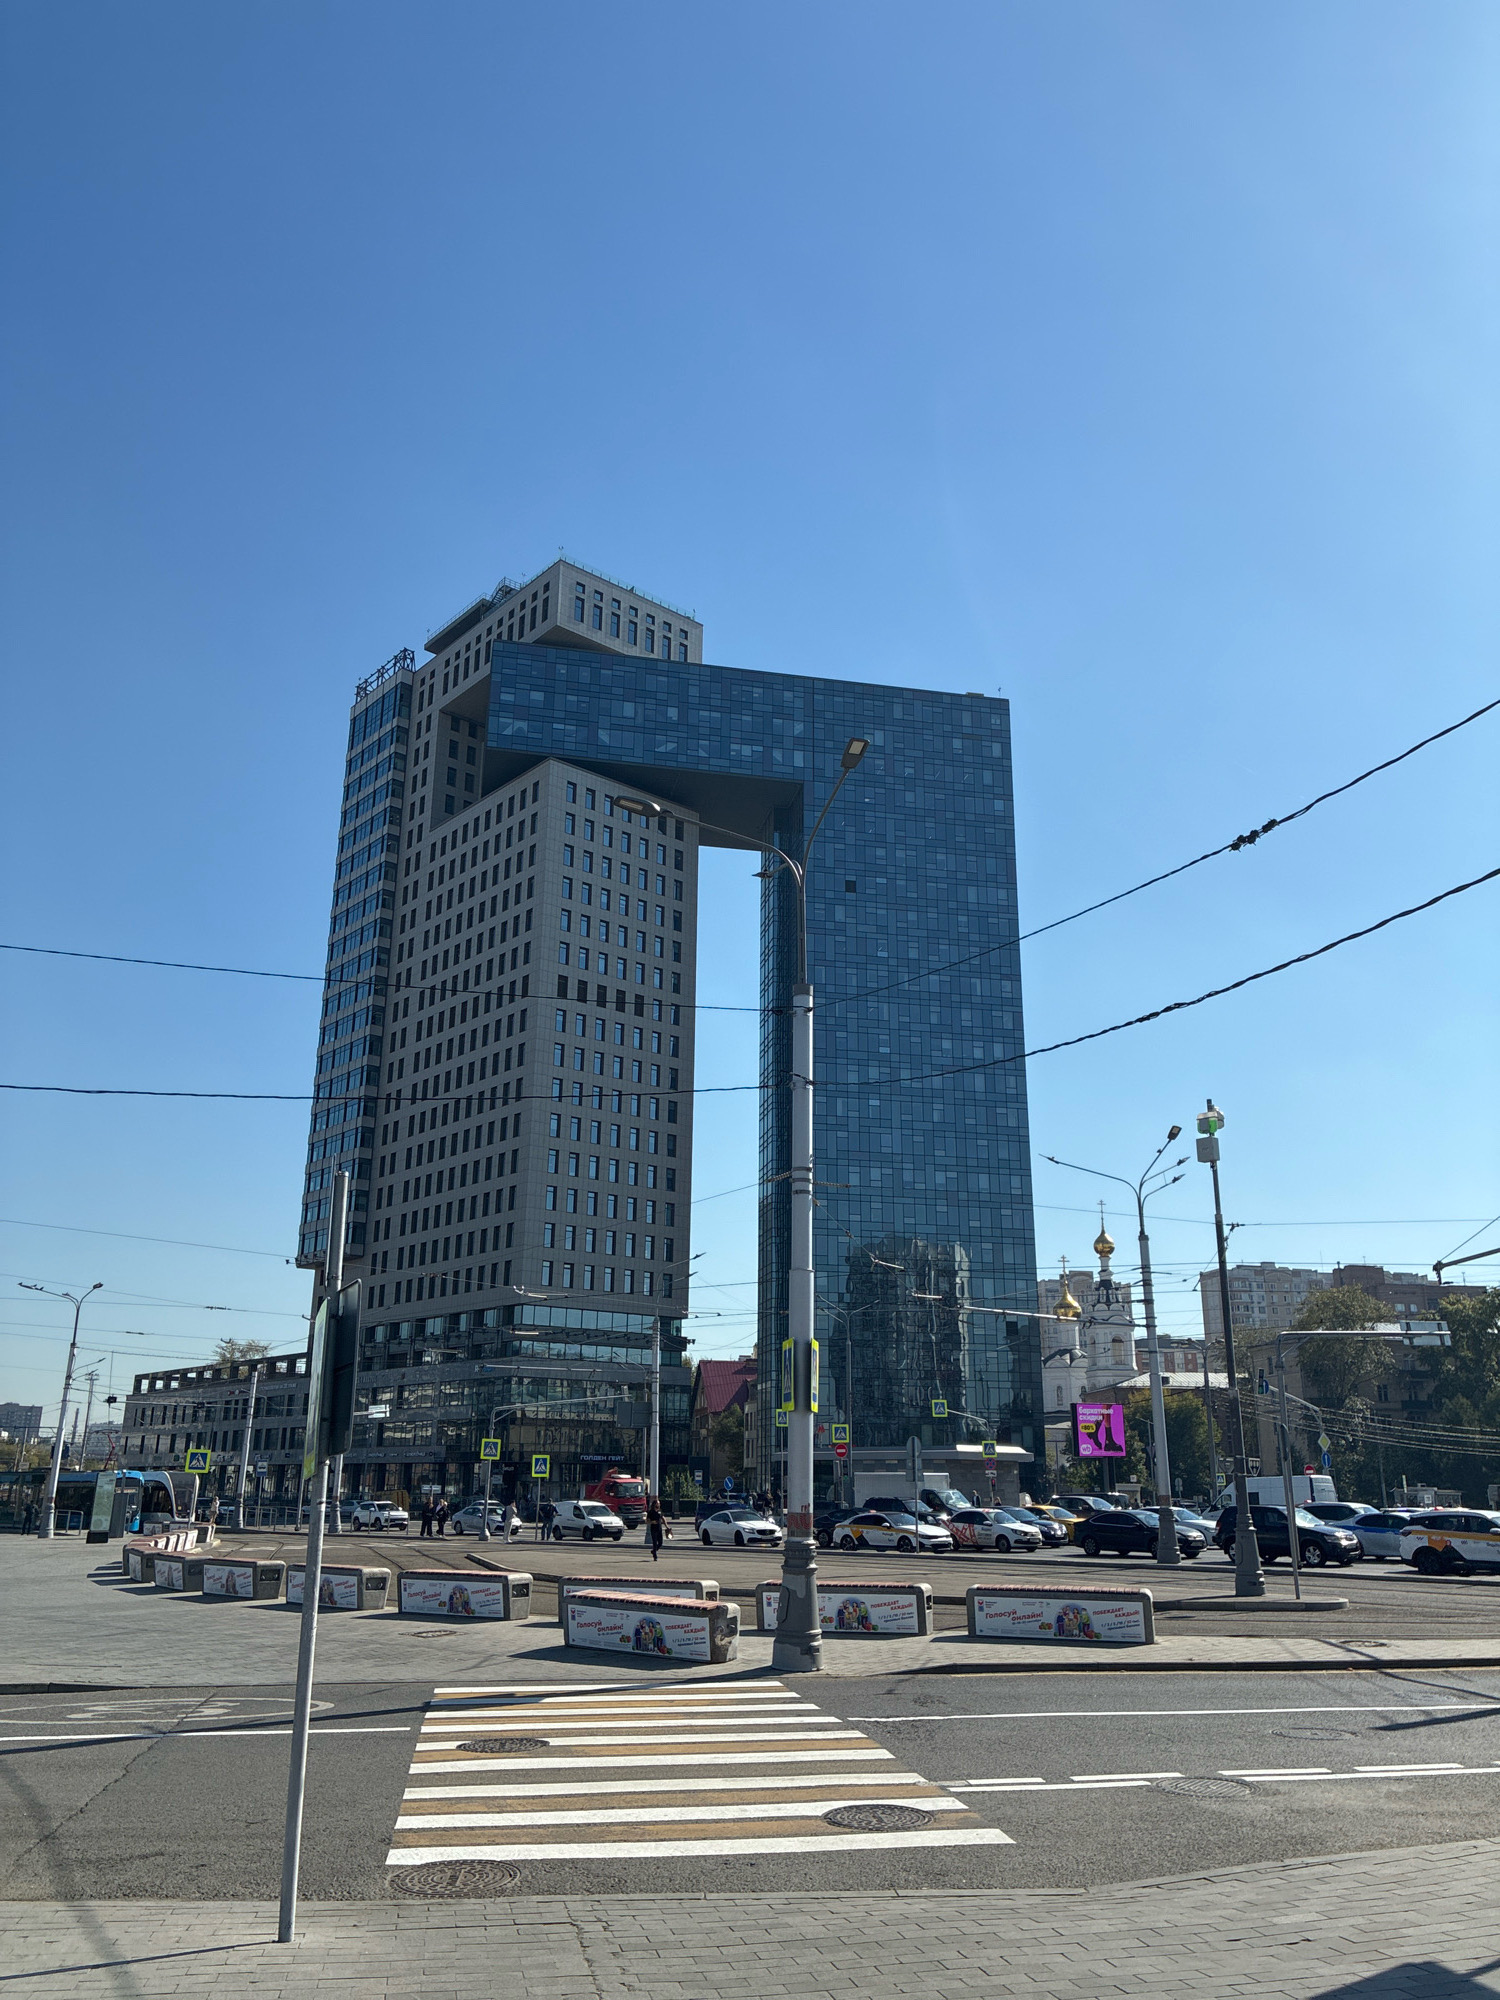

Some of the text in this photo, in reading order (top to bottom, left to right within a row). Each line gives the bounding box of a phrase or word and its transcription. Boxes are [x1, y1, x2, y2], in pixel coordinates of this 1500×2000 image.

[1079, 1407, 1114, 1415] бархатные
[985, 1609, 1017, 1620] Голосуй
[1011, 1611, 1044, 1622] онлайн!
[577, 1620, 602, 1629] Голосуй
[597, 1624, 624, 1632] онлайн!
